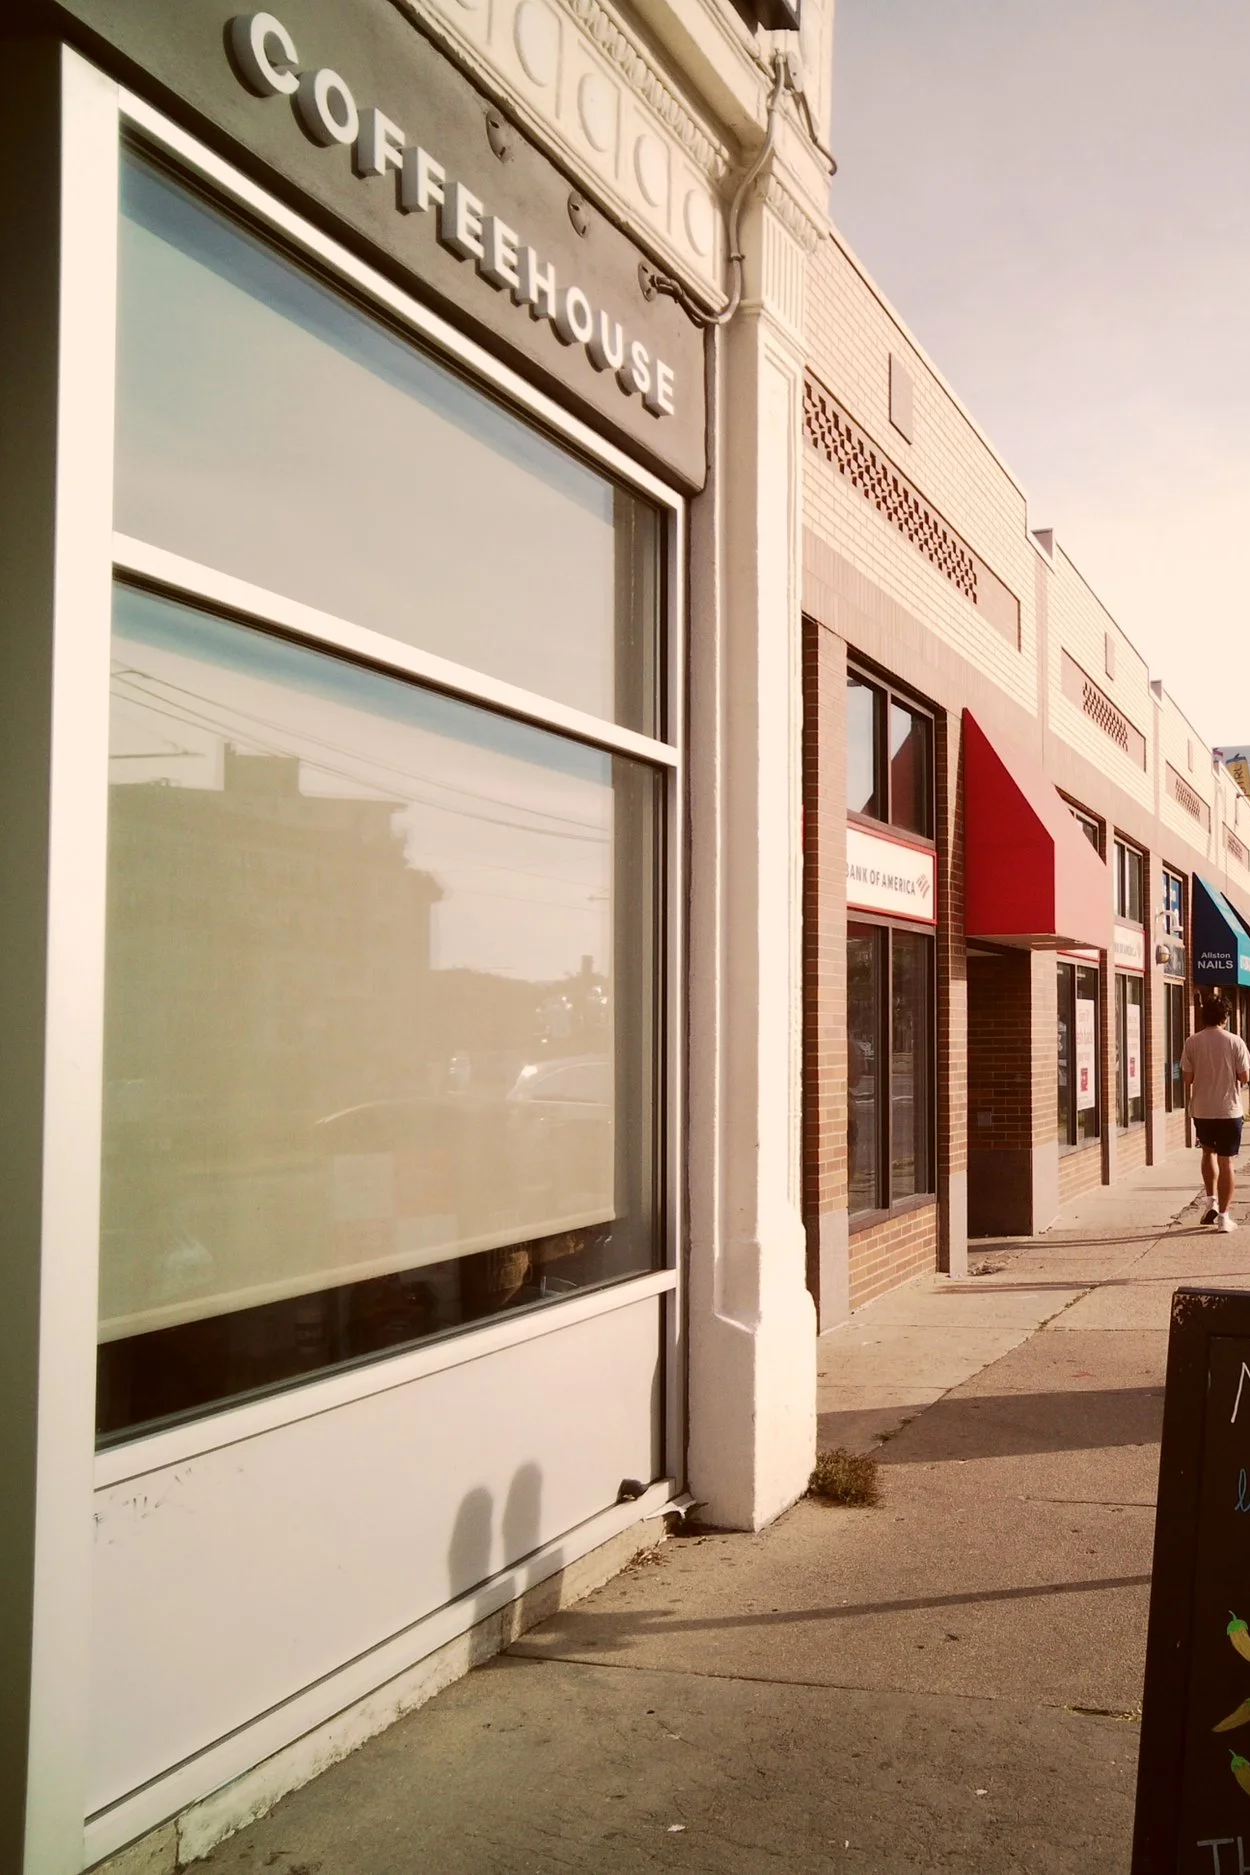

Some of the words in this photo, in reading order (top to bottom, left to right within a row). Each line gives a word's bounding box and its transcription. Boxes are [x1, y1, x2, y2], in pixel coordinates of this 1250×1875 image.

[232, 11, 675, 417] COFFEEHOUSE
[869, 870, 880, 885] OF
[881, 873, 916, 895] AMERICA
[1197, 960, 1234, 969] NAILS
